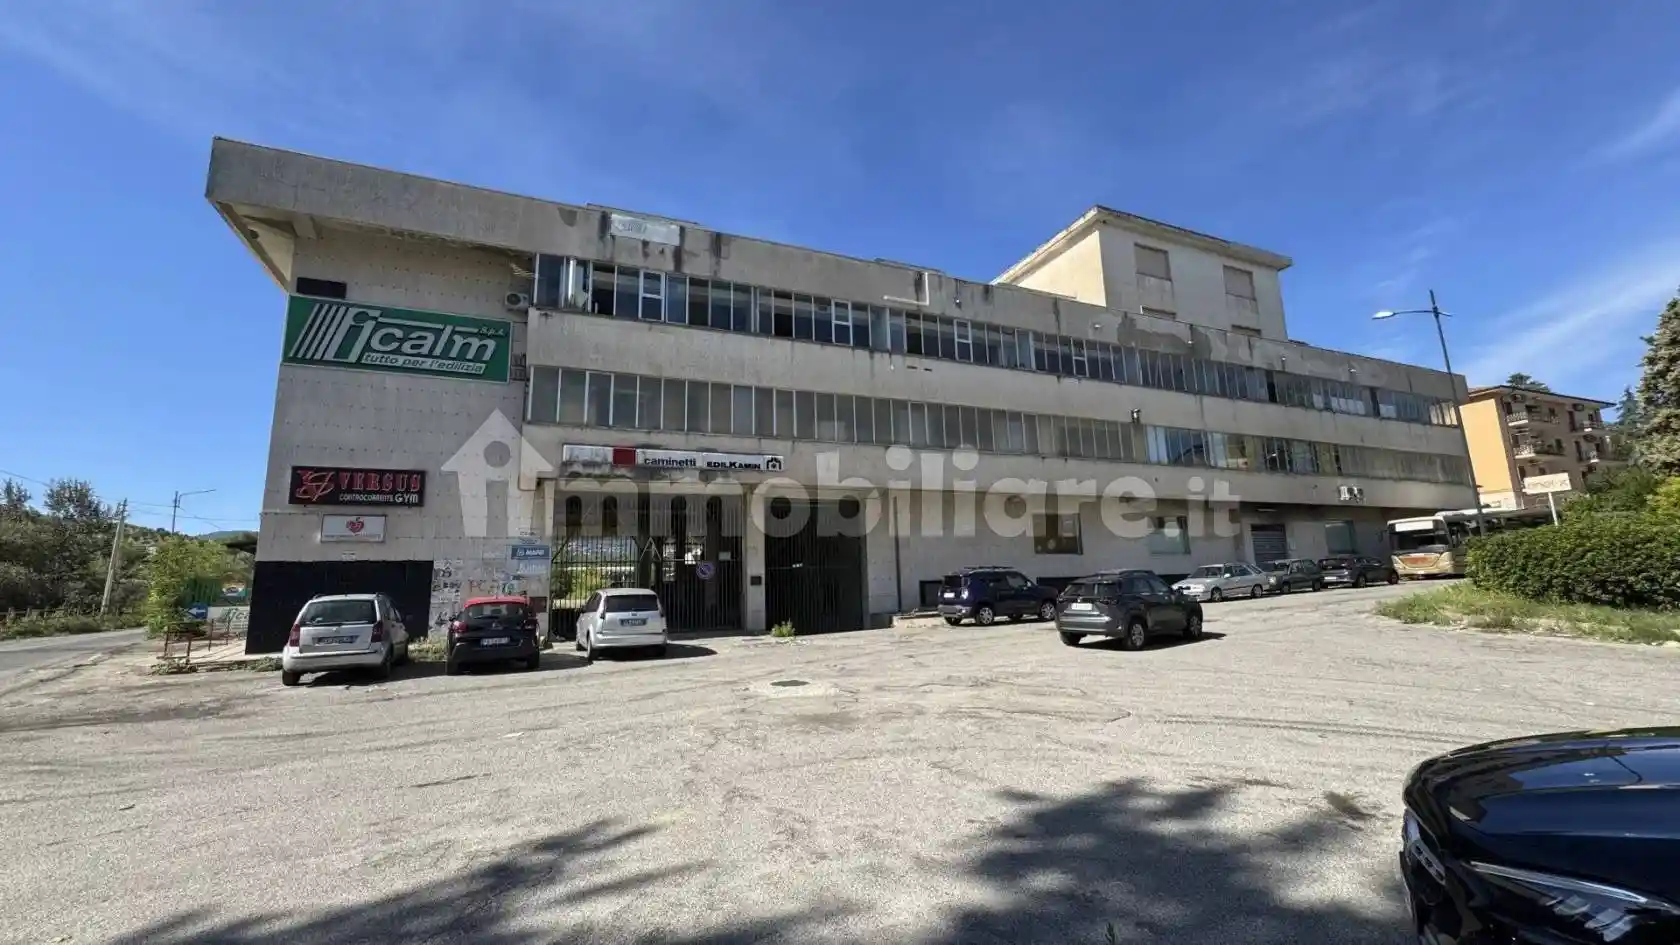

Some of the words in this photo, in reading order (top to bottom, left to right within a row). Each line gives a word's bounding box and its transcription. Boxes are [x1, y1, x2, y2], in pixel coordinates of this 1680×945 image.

[363, 353, 400, 366] tutto
[402, 358, 425, 369] per
[429, 360, 483, 374] l'edilizia
[643, 457, 697, 468] caminetti
[339, 471, 421, 493] VERSUS
[394, 493, 419, 504] GYM
